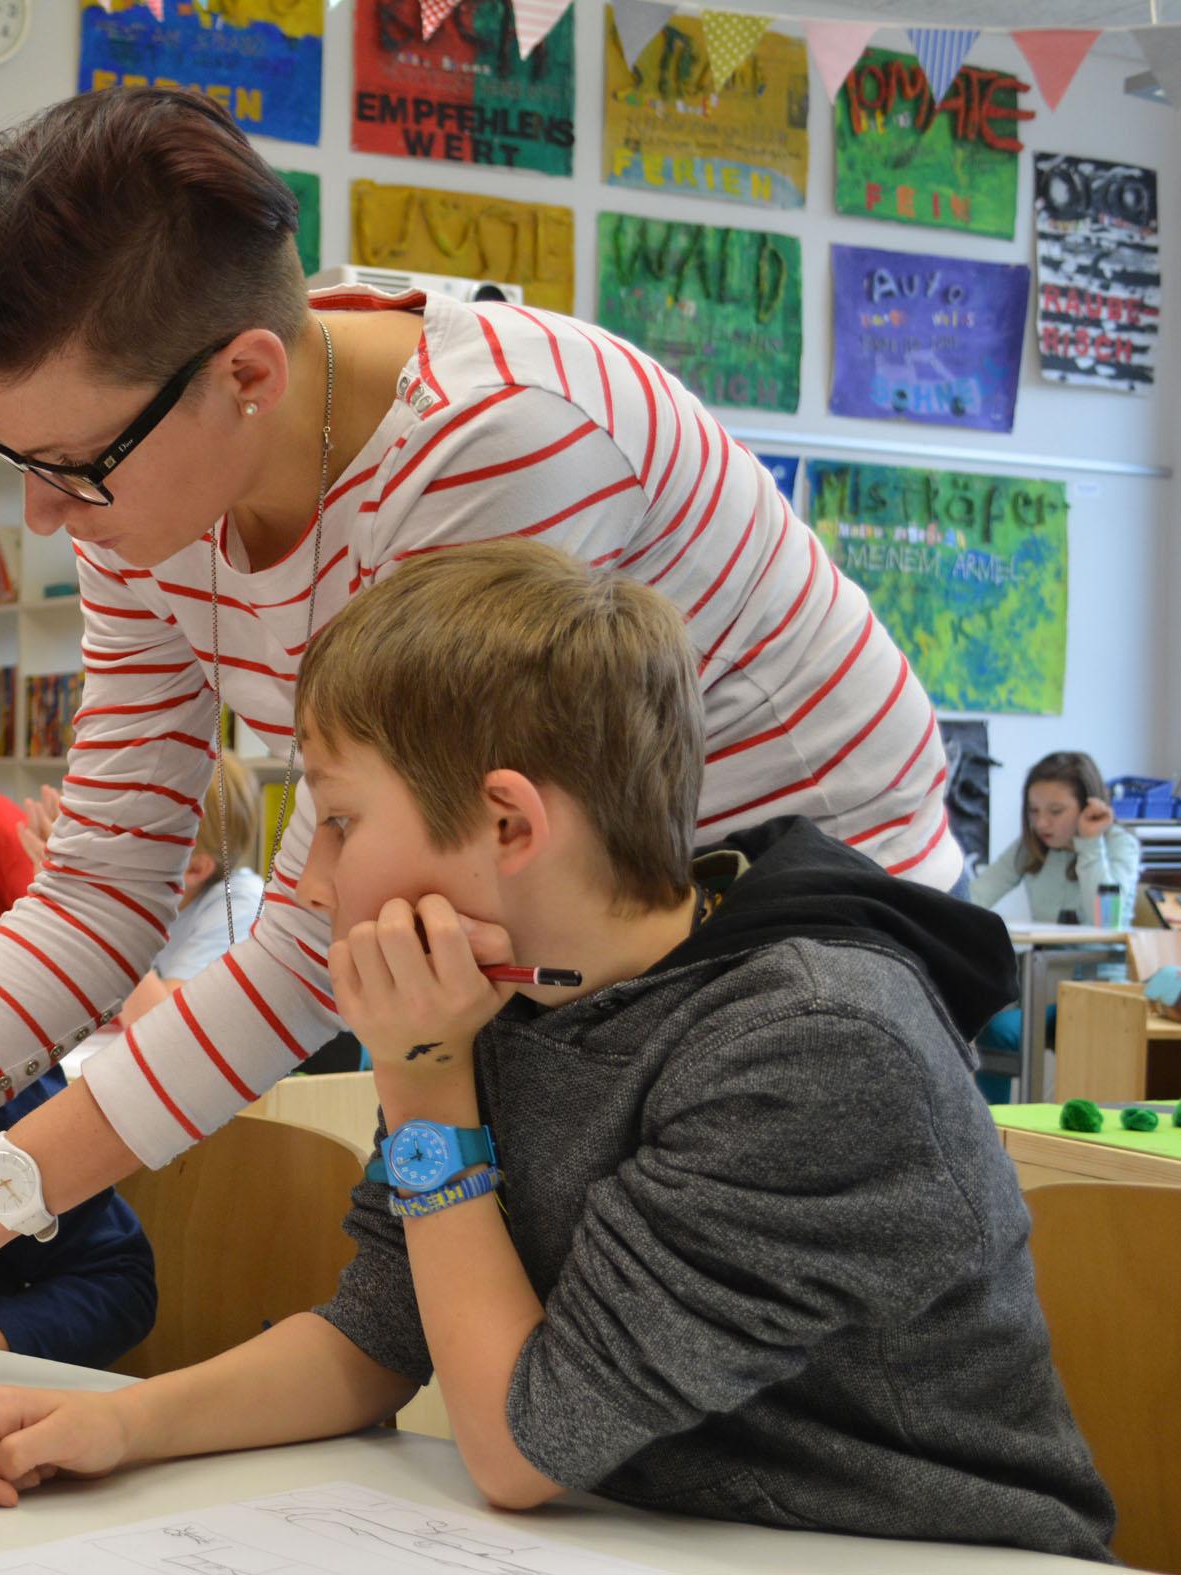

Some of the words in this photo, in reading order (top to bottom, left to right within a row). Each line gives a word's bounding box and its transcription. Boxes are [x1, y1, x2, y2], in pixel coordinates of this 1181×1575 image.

[92, 69, 262, 122] FEN
[356, 92, 575, 148] EMPFEHLENS
[402, 129, 520, 167] WERT
[613, 149, 772, 201] FERIEN
[865, 182, 972, 223] FEIN
